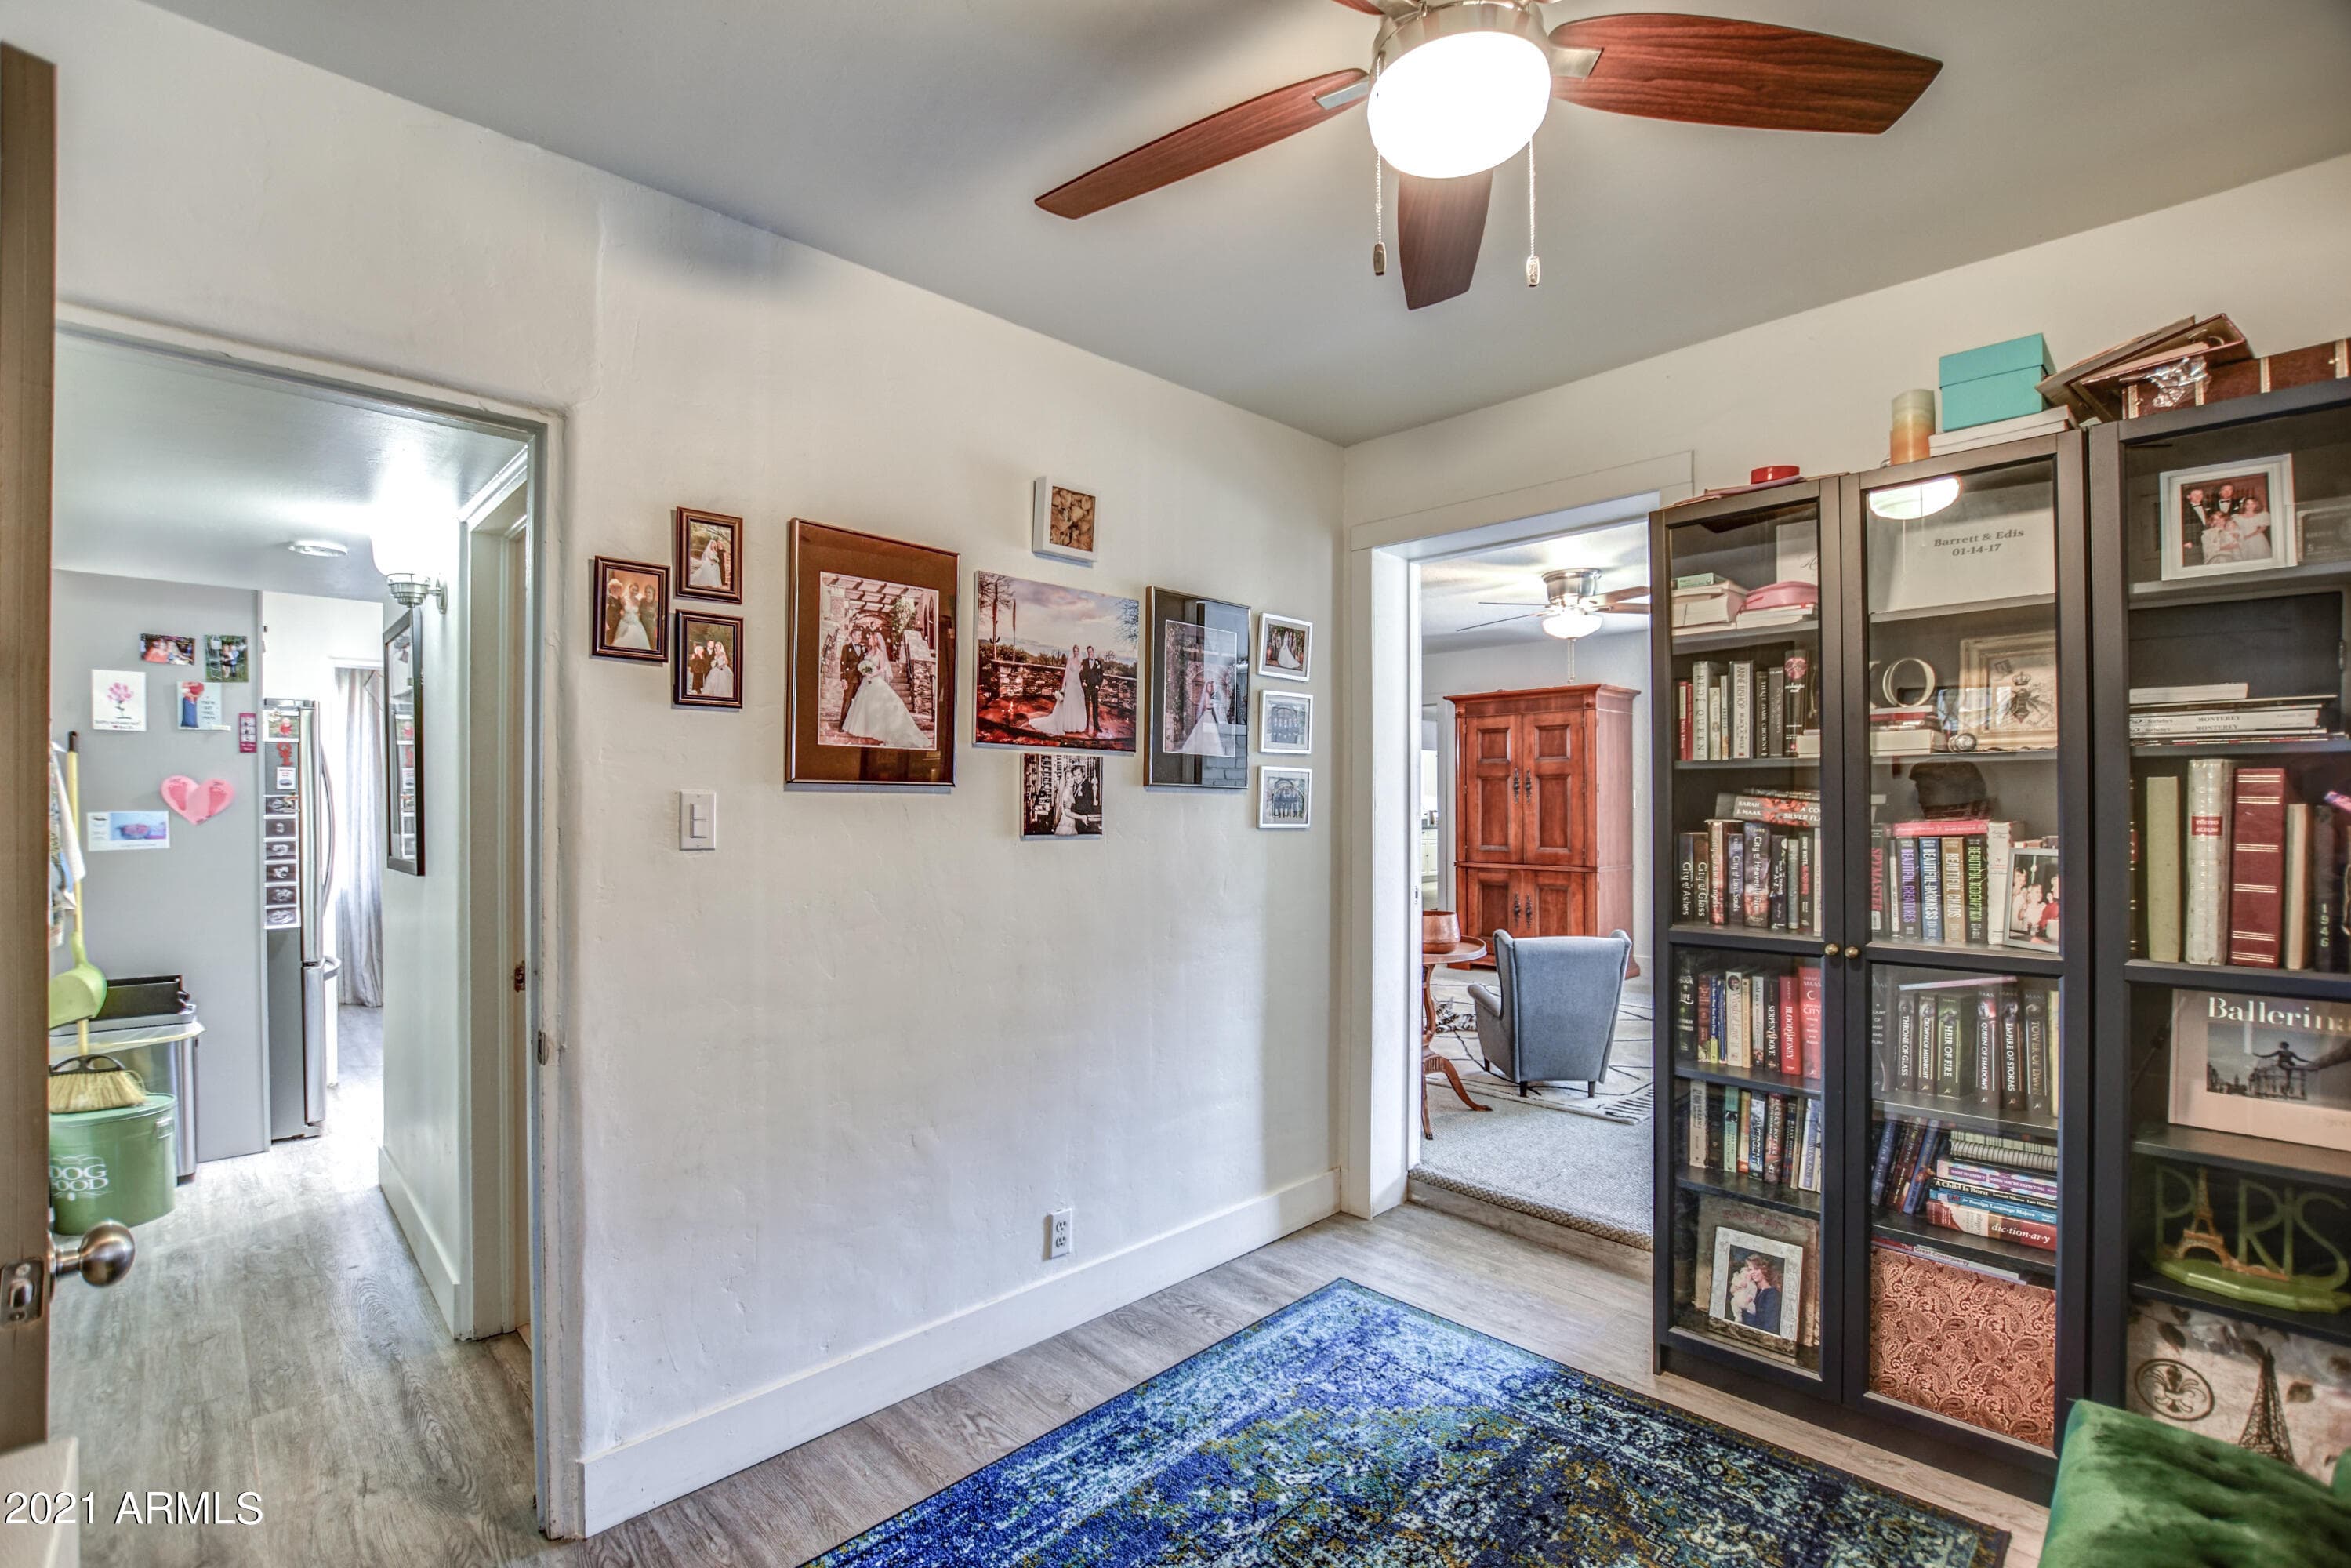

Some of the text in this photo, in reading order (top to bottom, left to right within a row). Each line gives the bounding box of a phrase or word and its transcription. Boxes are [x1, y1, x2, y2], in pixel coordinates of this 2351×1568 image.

[1933, 535, 1979, 547] Barrett
[1995, 529, 2025, 539] Edis
[1951, 543, 2002, 557] 01-14-17
[1695, 710, 1705, 751] QUEEN
[1751, 836, 1762, 851] City
[1681, 862, 1691, 880] City
[1696, 862, 1707, 881] City
[1731, 855, 1740, 869] City
[1946, 853, 1960, 891] BEAUTIFUL
[1968, 847, 1982, 880] BEAUTIFUL
[1753, 861, 1762, 895] Heavenly
[1871, 848, 1882, 911] SPYMASTER
[1900, 849, 1916, 923] BEAUTIFUL CREATURES
[1923, 848, 1939, 920] BEAUTIFUL DARKNESS
[1682, 891, 1691, 916] Ashes
[1698, 892, 1707, 916] Glass
[1946, 894, 1961, 918] CHAOS
[1968, 882, 1983, 922] REDEMPTION
[2320, 903, 2329, 947] 1946
[1785, 1006, 1794, 1029] BLOOD
[1785, 1035, 1794, 1059] HONEY
[1902, 1043, 1909, 1052] OF
[1943, 1025, 1953, 1077] HEIR OF FIRE
[1981, 1047, 1988, 1055] OF
[2006, 1051, 2014, 1061] OF
[2031, 1022, 2041, 1096] TOWER OF DAWN
[2007, 1062, 2015, 1092] STORMS
[1751, 1116, 1761, 1167] DIVERGENT
[1772, 1127, 1780, 1155] POTTER
[49, 1163, 107, 1181] DOG
[52, 1178, 109, 1192] OOD
[1970, 1187, 1989, 1196] Born
[1969, 1200, 1989, 1208] Foreign
[1990, 1203, 2015, 1214] Language
[1914, 1247, 1932, 1256] Great
[1932, 1250, 1970, 1267] Controversy
